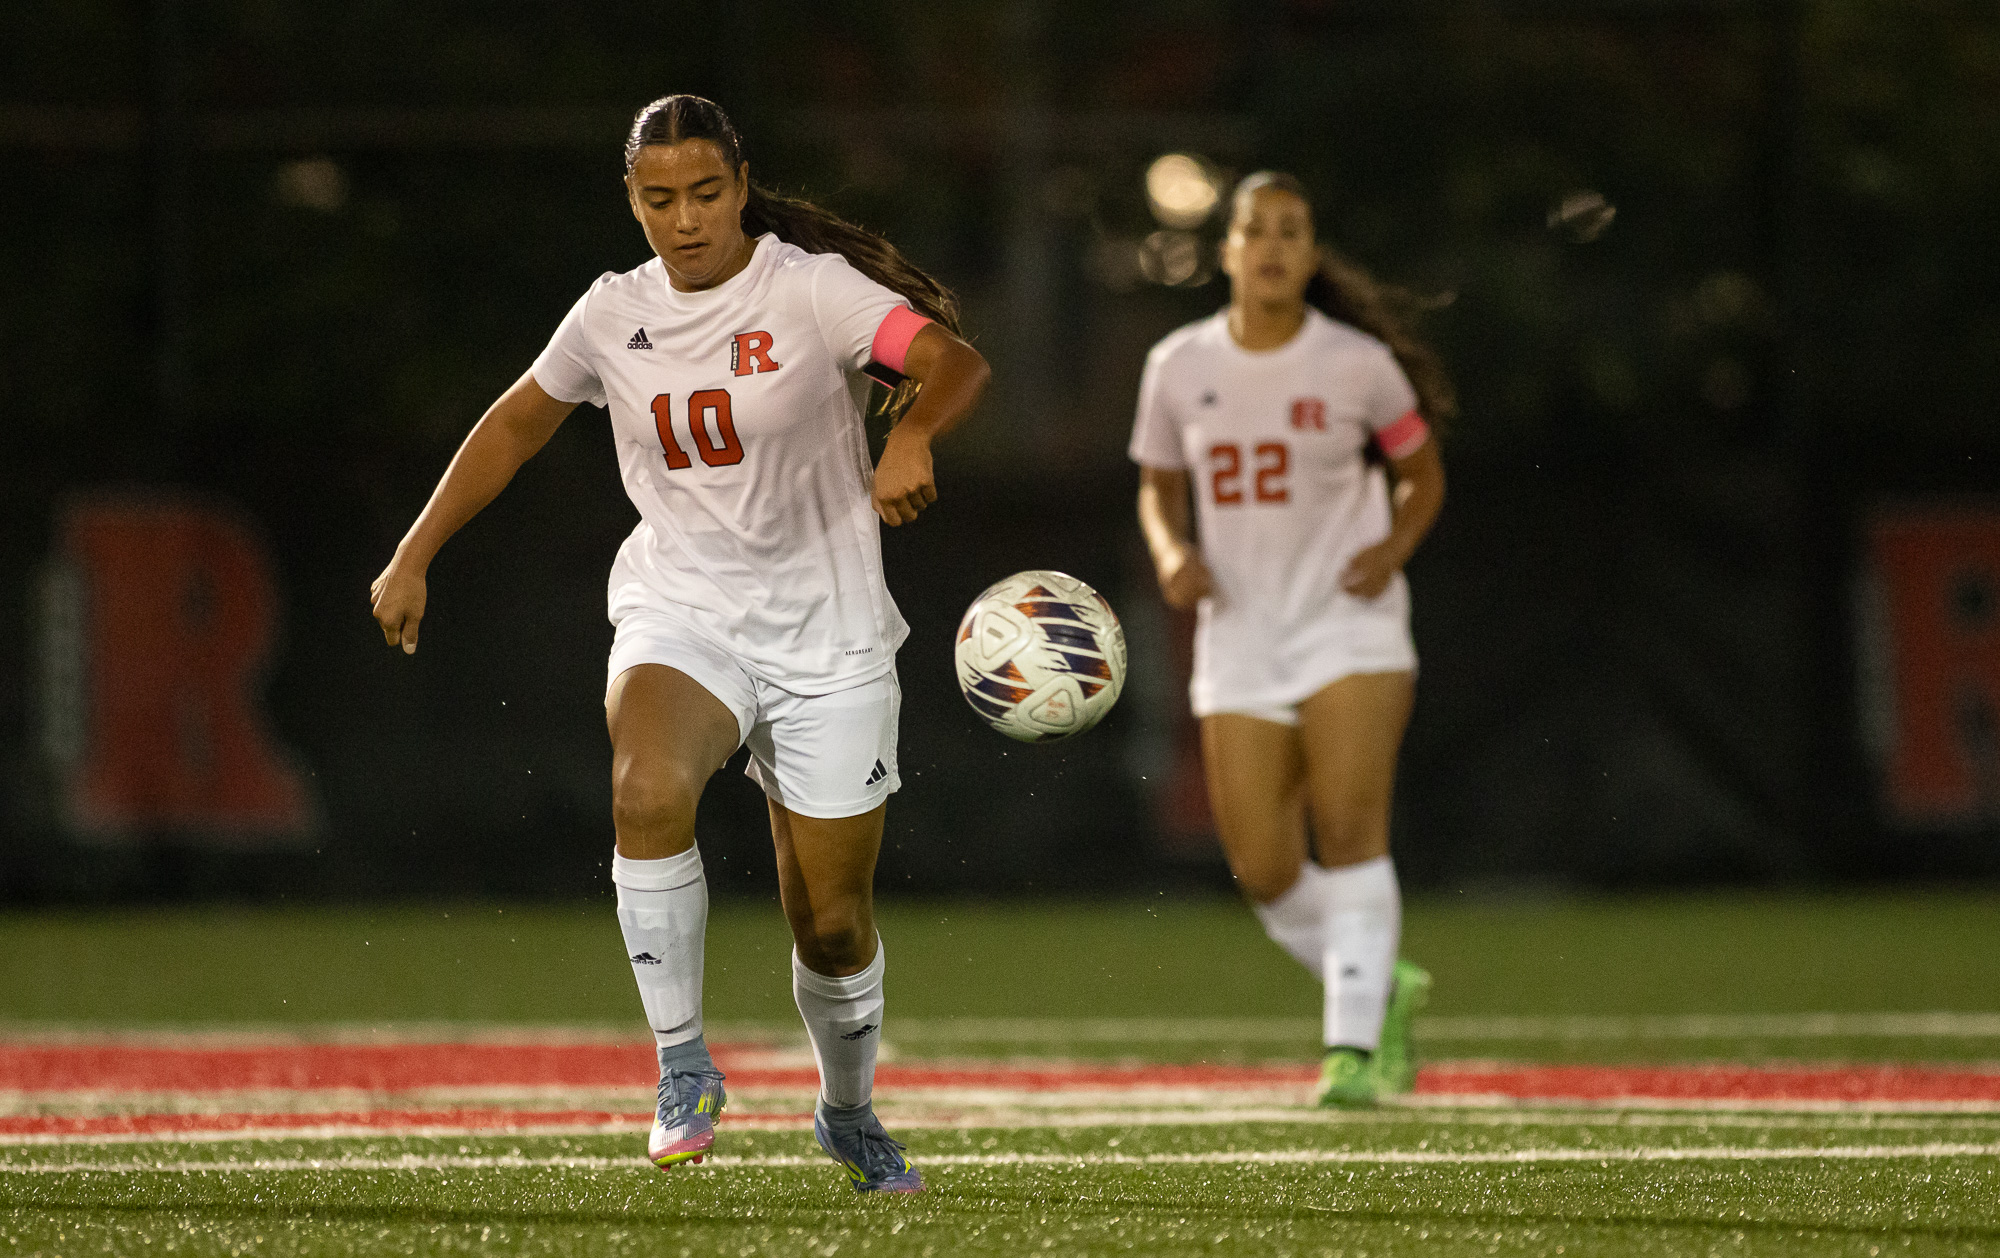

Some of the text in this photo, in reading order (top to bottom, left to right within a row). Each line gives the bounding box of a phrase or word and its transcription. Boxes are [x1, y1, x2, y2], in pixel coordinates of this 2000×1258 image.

[627, 342, 653, 350] adidas
[734, 330, 779, 377] R
[651, 388, 745, 471] 10
[1208, 442, 1290, 505] 22
[65, 500, 315, 835] R
